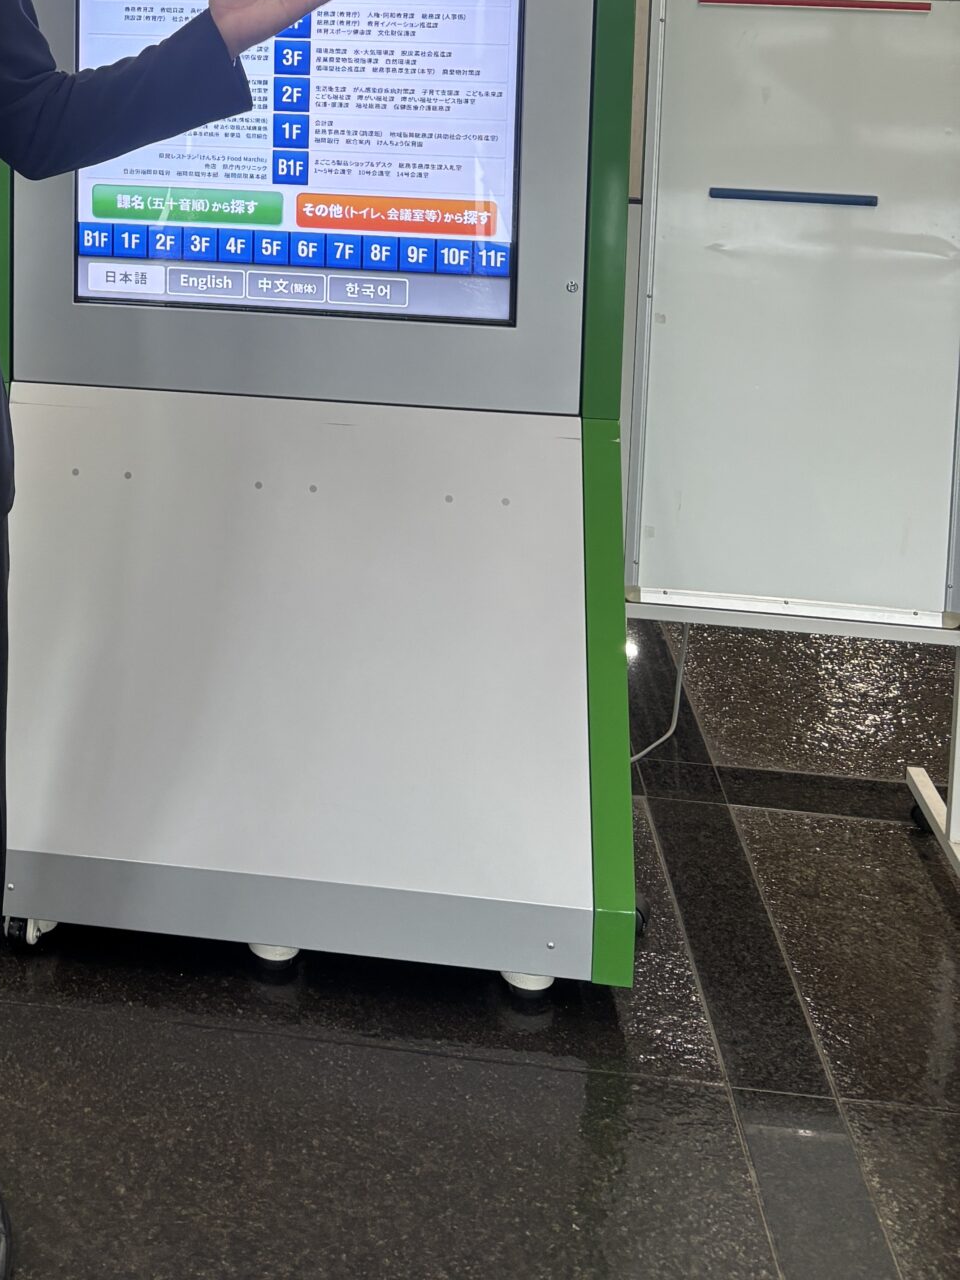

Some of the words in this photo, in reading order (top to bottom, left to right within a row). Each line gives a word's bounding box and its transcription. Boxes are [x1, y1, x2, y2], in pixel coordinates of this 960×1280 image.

[282, 50, 303, 66] 3F
[281, 86, 302, 103] 2F
[282, 122, 302, 139] 1F
[278, 159, 303, 176] B1F
[84, 231, 108, 247] B1F
[121, 232, 140, 249] 1F
[156, 234, 175, 250] 2F
[190, 235, 210, 252] 3F
[225, 237, 246, 254] 4F
[261, 238, 282, 256] 5F
[297, 240, 318, 258] 6F
[334, 242, 354, 260] 7F
[370, 244, 391, 262] 8F
[407, 246, 428, 264] 9F
[441, 248, 470, 266] 10F
[478, 249, 506, 268] 11F
[105, 271, 148, 285] 日本語
[180, 273, 233, 291] English
[346, 282, 391, 300] 한국어
